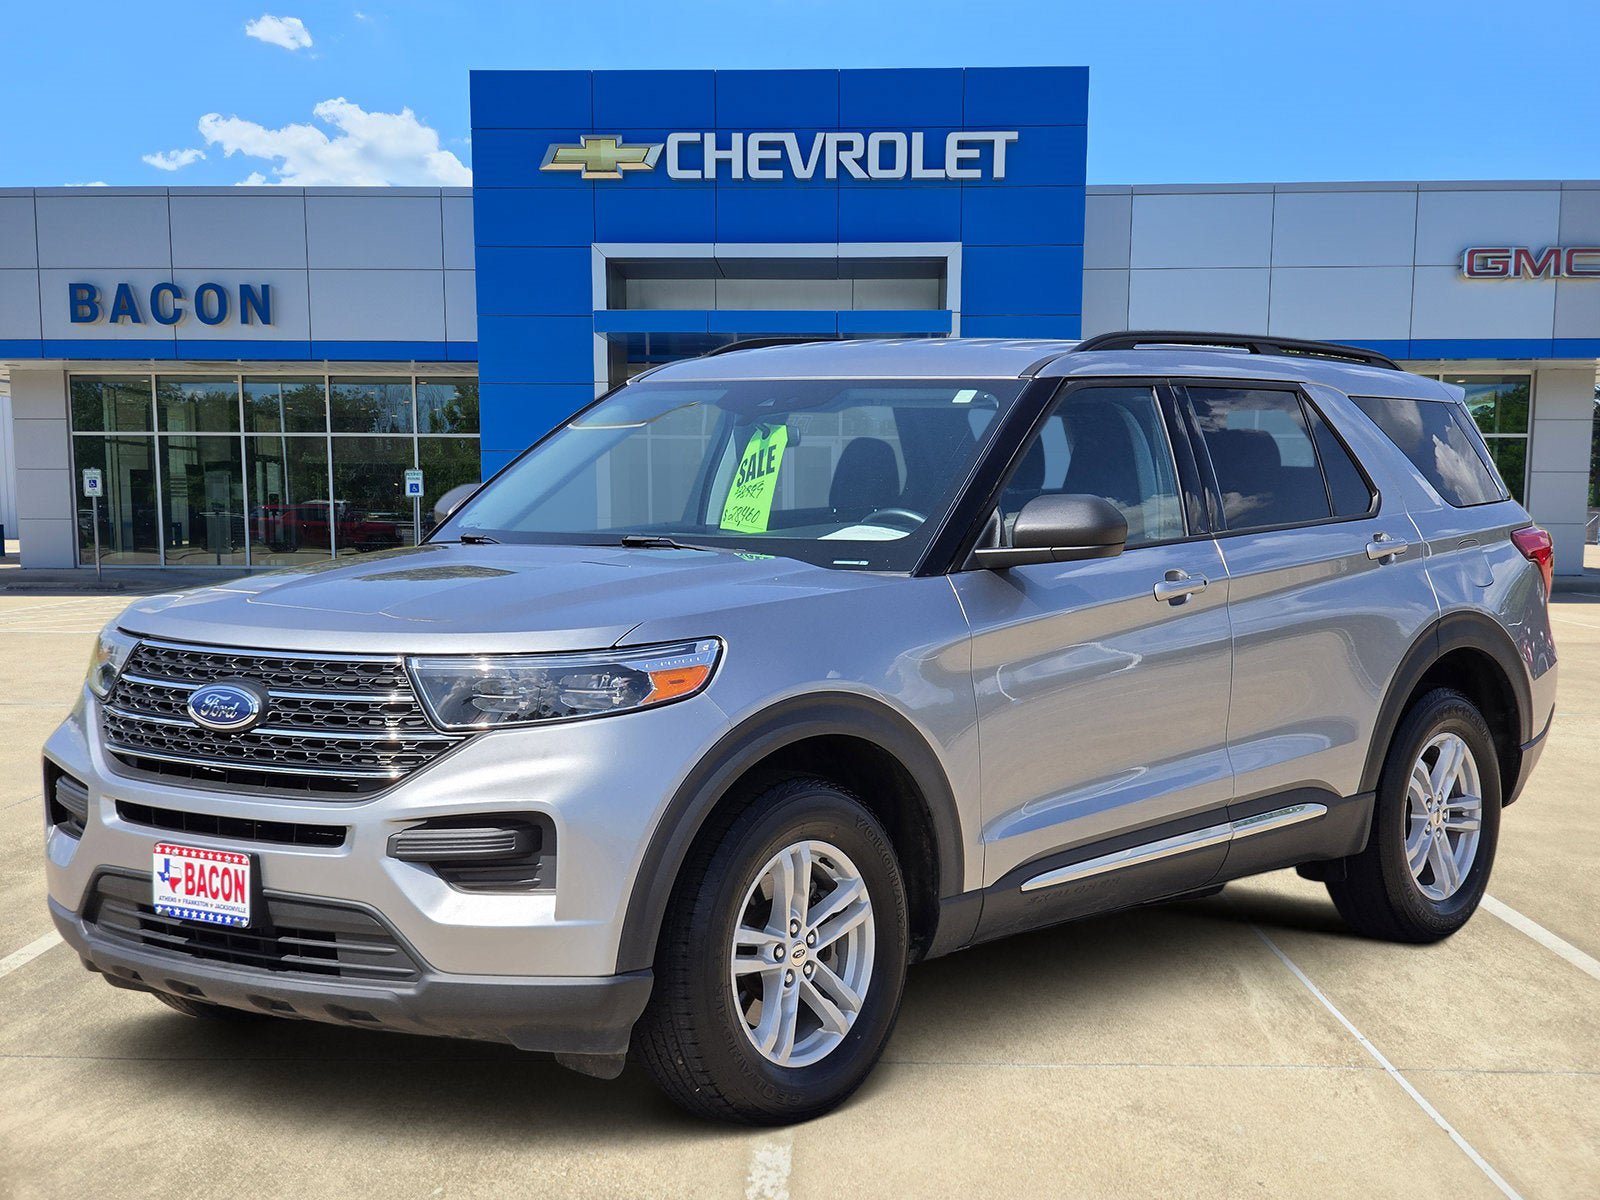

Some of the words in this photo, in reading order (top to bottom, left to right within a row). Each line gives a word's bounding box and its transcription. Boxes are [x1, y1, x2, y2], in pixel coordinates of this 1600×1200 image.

[666, 131, 1019, 180] CHEVROLET
[1463, 246, 1600, 278] GMC
[69, 282, 272, 326] BACON
[736, 444, 777, 488] SALE
[200, 693, 240, 719] Ford
[184, 862, 246, 904] BACON
